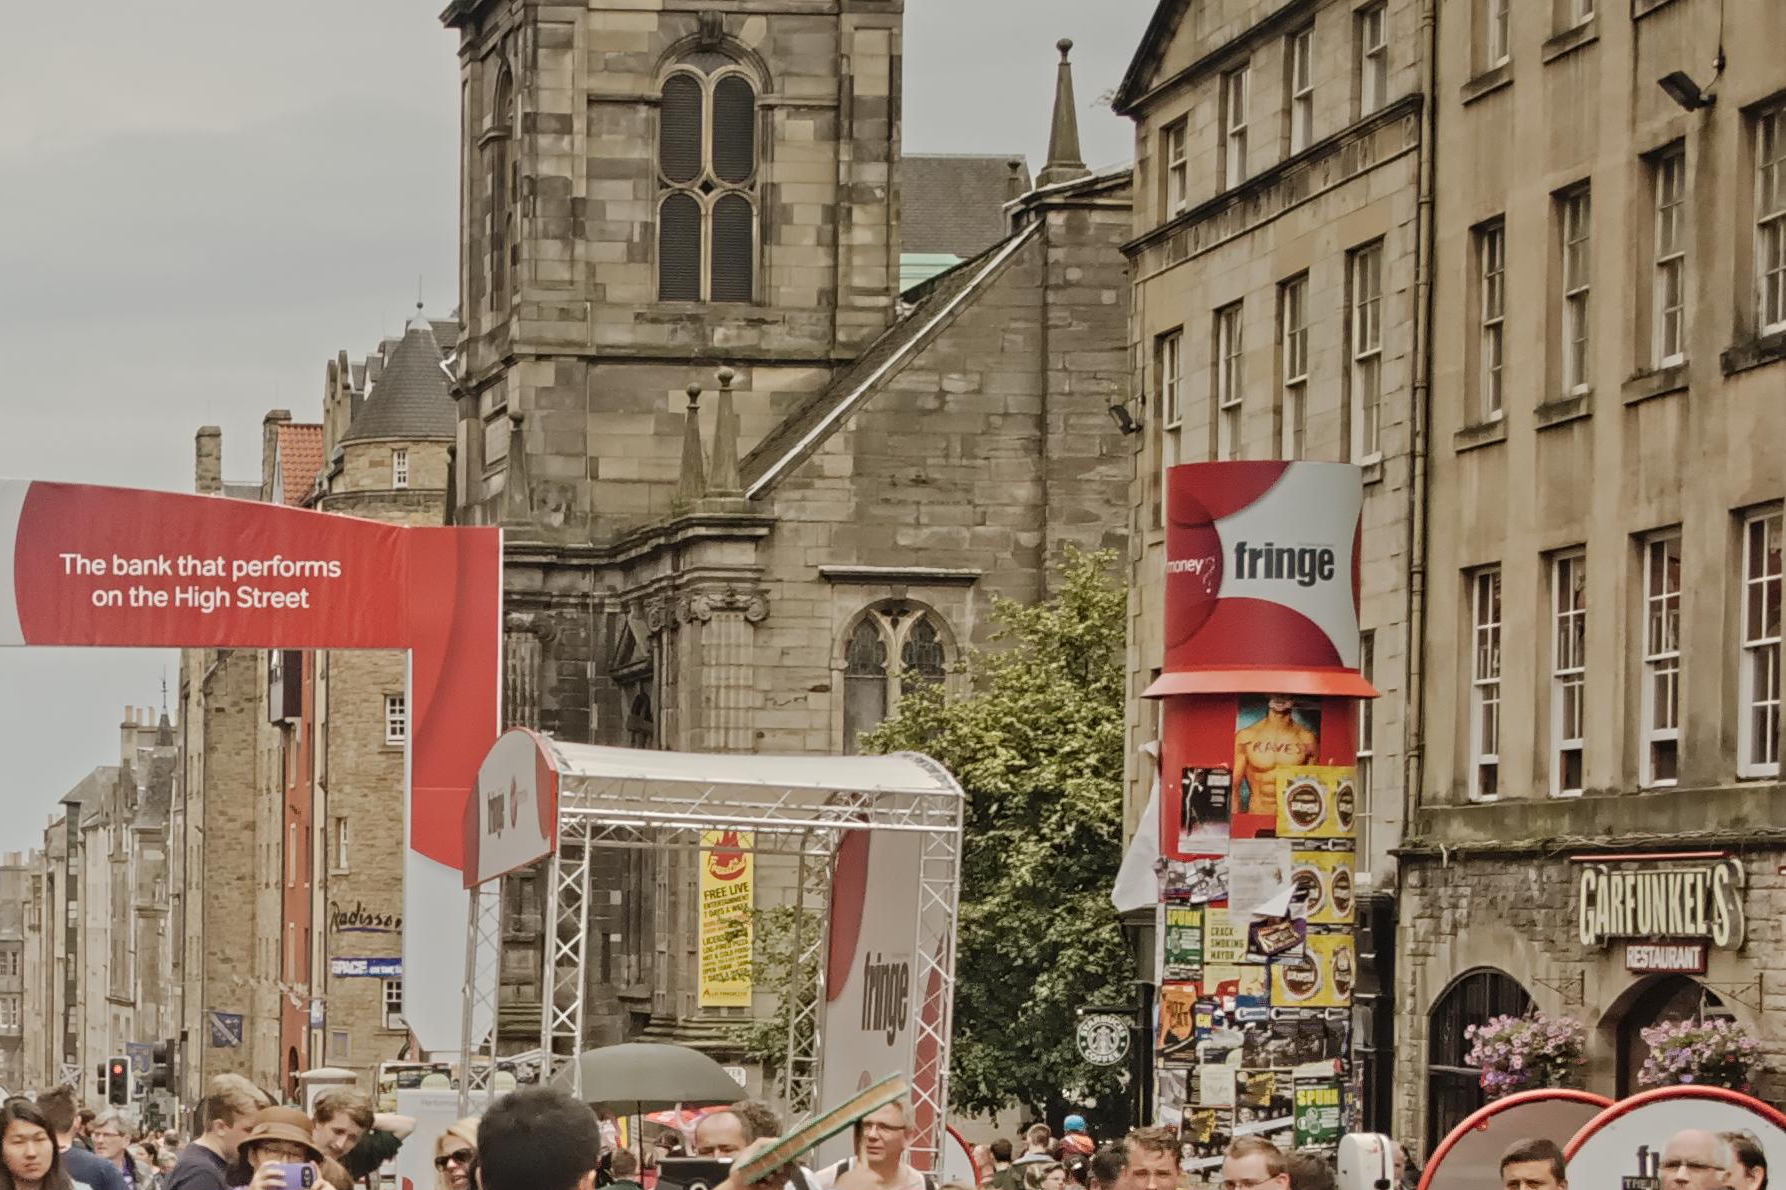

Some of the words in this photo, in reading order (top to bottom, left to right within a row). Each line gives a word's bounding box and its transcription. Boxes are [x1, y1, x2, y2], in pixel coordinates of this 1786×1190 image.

[59, 553, 106, 576] The
[113, 554, 172, 576] bank
[177, 555, 226, 577] that
[232, 555, 341, 582] performs
[1234, 541, 1335, 587] fringe
[92, 589, 123, 607] on
[128, 586, 168, 607] the
[175, 586, 230, 613] High
[236, 586, 310, 608] Street
[704, 885, 727, 901] FREE
[729, 881, 749, 896] LIVE
[1579, 863, 1731, 947] GARFUNKEL'S
[1210, 938, 1244, 949] SMOKING
[1210, 950, 1235, 961] MAYOR
[1626, 945, 1702, 969] RESTAURANT
[861, 951, 909, 1047] fringe
[1296, 1088, 1340, 1106] SPUNK
[1626, 1179, 1646, 1190] THE
